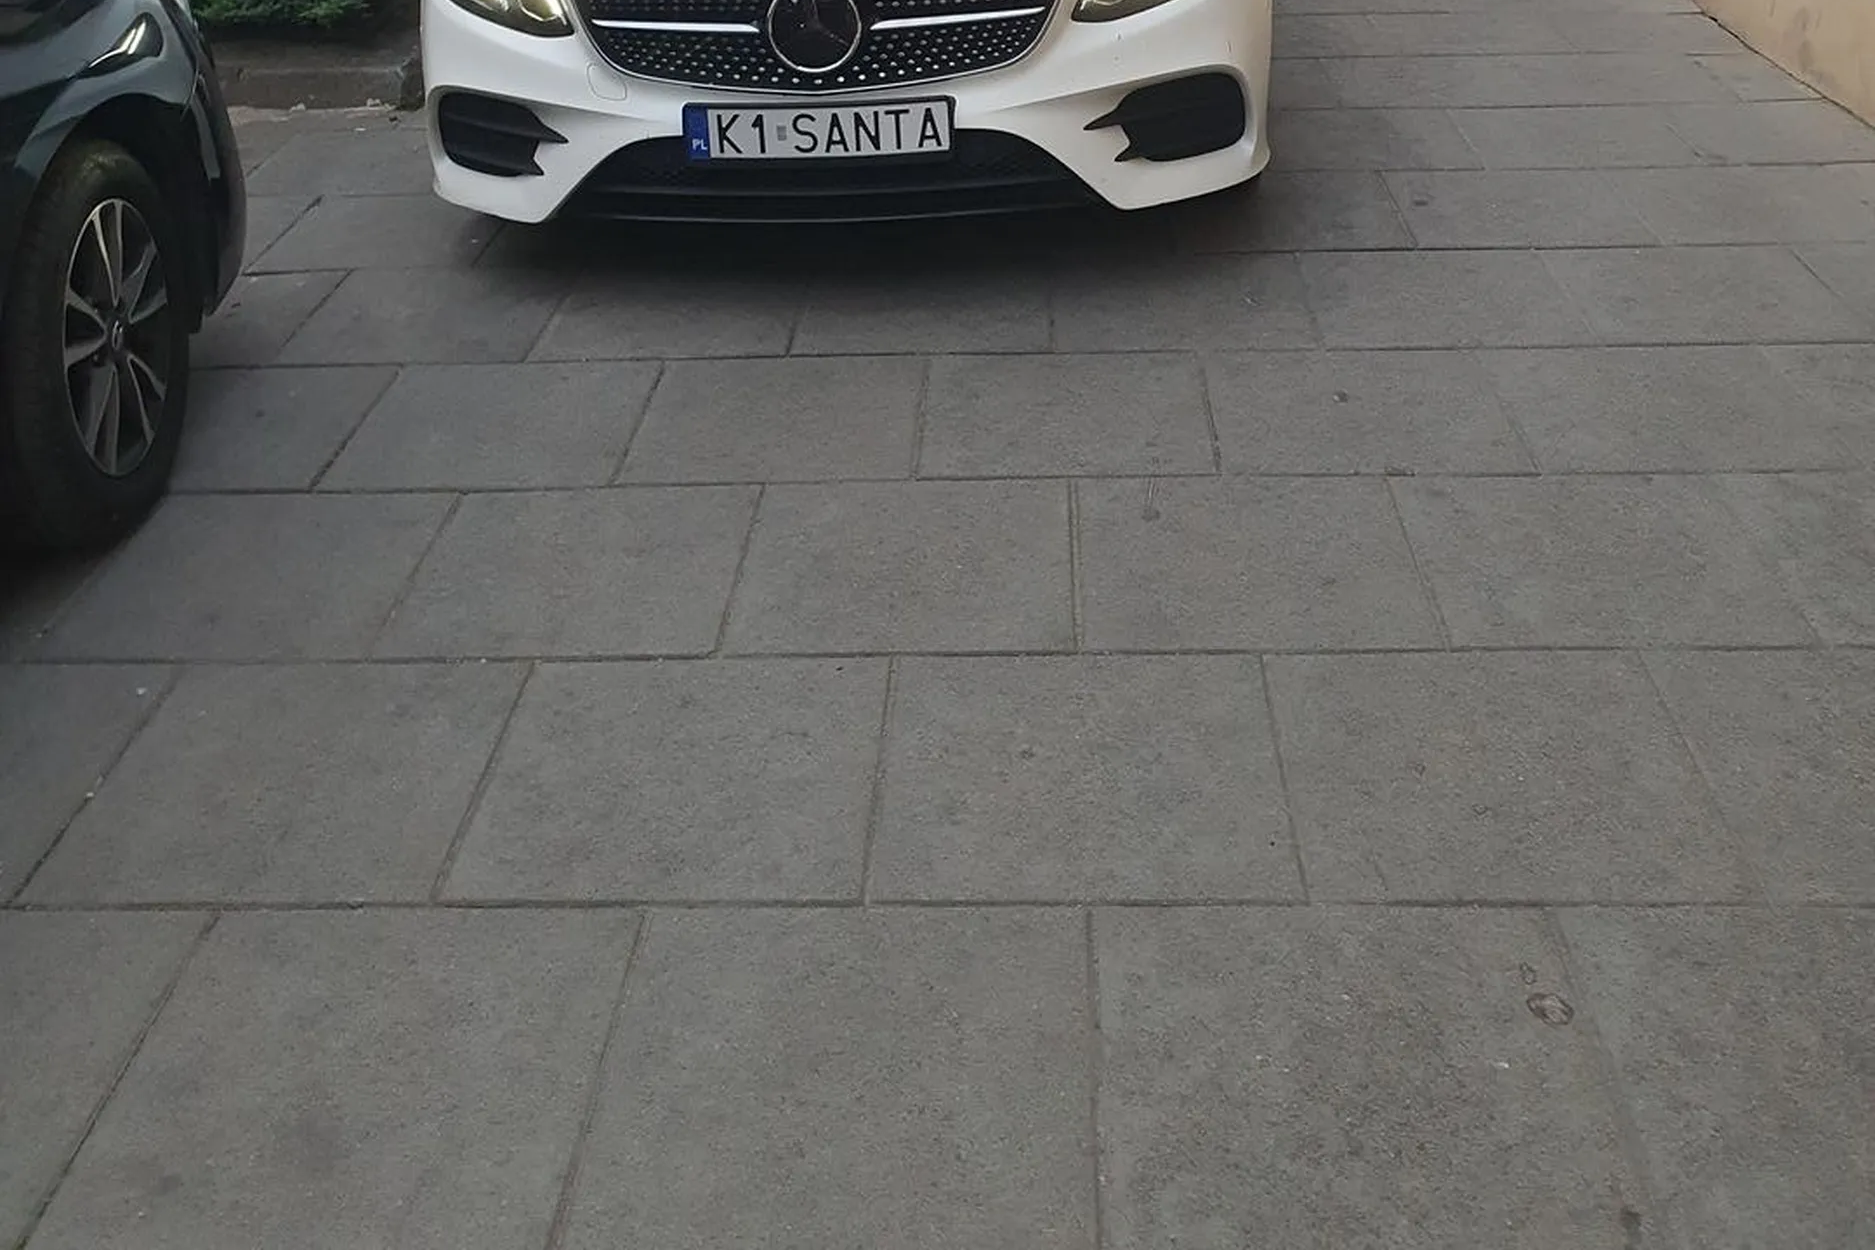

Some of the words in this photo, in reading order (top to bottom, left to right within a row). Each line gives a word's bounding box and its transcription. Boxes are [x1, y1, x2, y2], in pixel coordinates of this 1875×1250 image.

[692, 138, 708, 151] PL
[716, 113, 766, 154] K1
[792, 107, 943, 154] SANTA
